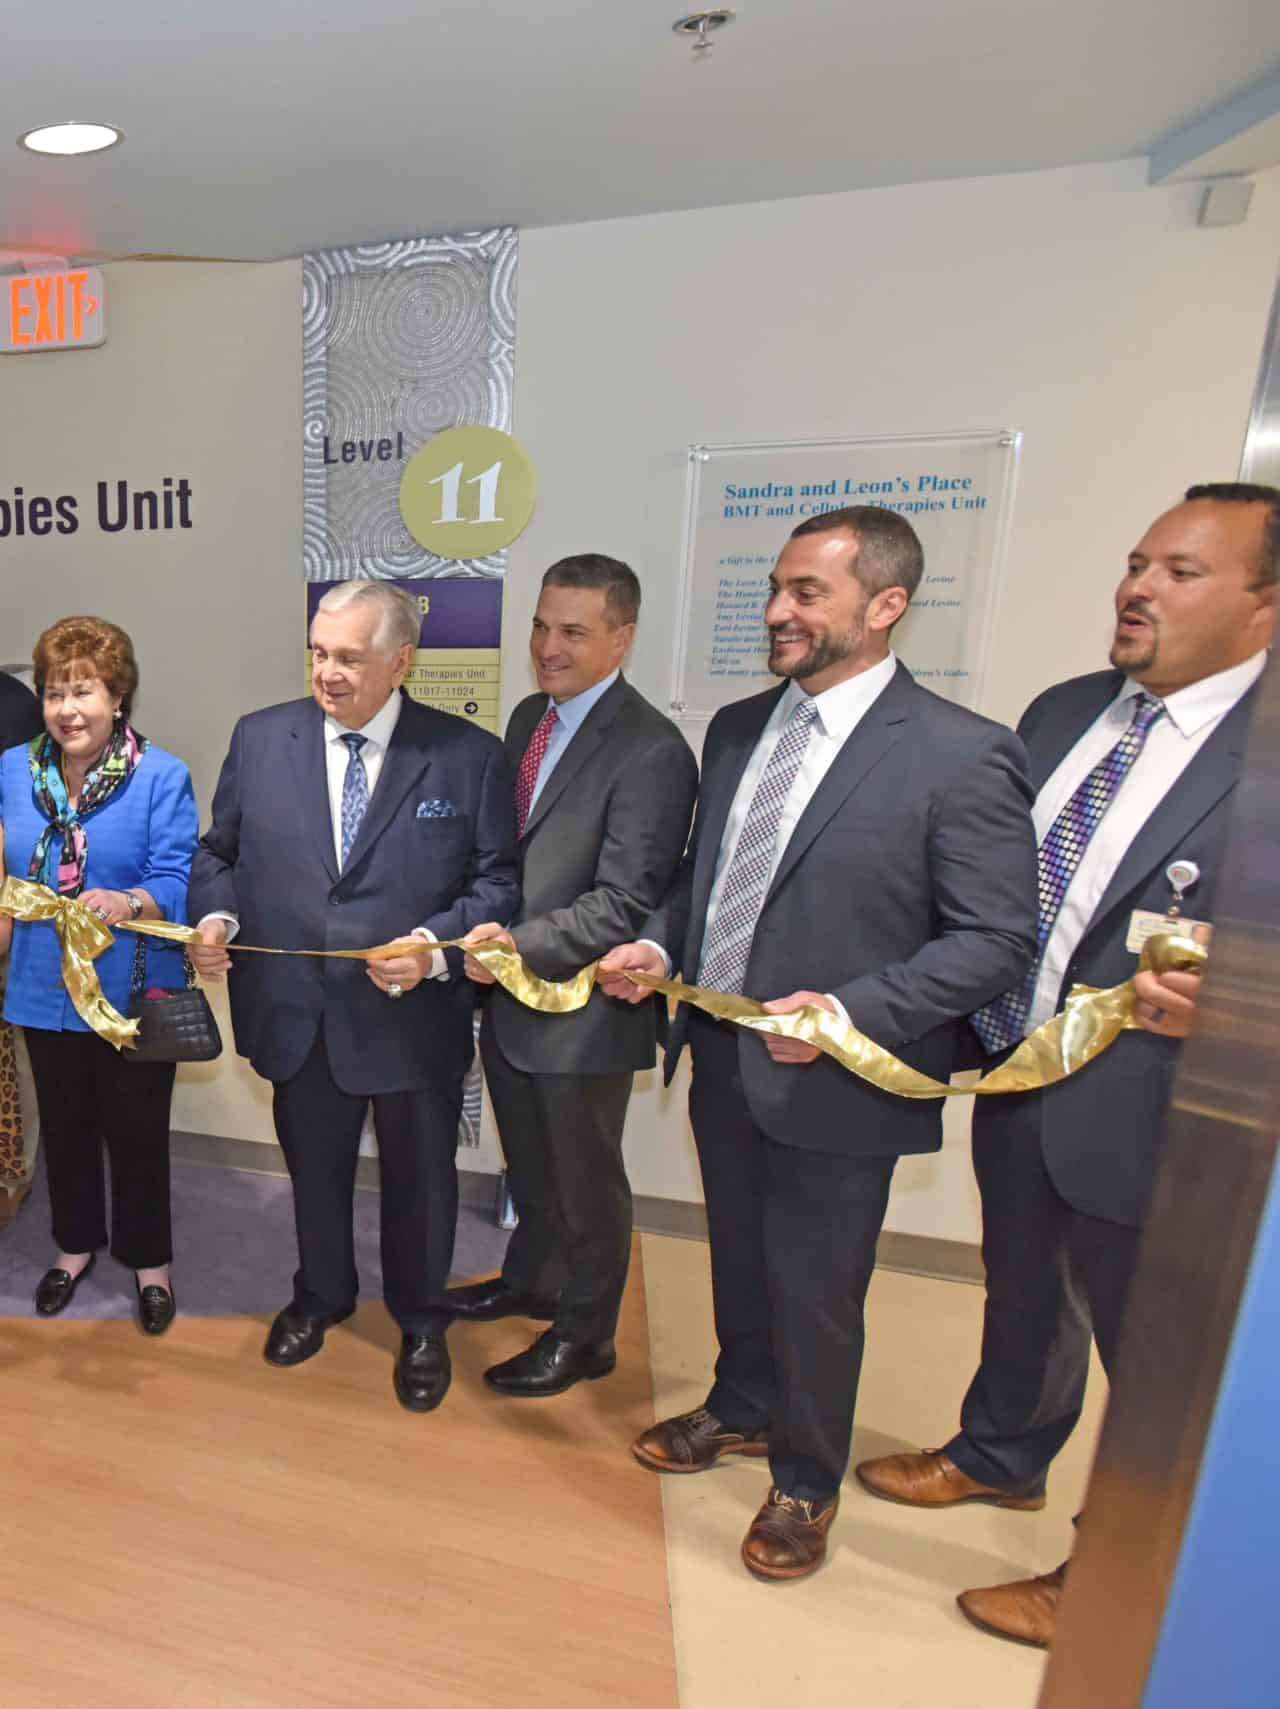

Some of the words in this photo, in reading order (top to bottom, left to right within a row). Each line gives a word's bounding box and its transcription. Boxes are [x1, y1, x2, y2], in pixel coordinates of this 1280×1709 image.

[10, 272, 88, 345] EXIT
[323, 431, 403, 465] Level
[97, 477, 193, 533] Unit
[426, 461, 507, 524] 11
[723, 503, 761, 518] BMT
[767, 503, 794, 517] and
[951, 496, 987, 511] Unit
[724, 482, 793, 499] Sandra
[800, 479, 836, 496] and
[843, 476, 910, 496] Leon's
[918, 475, 973, 491] Place
